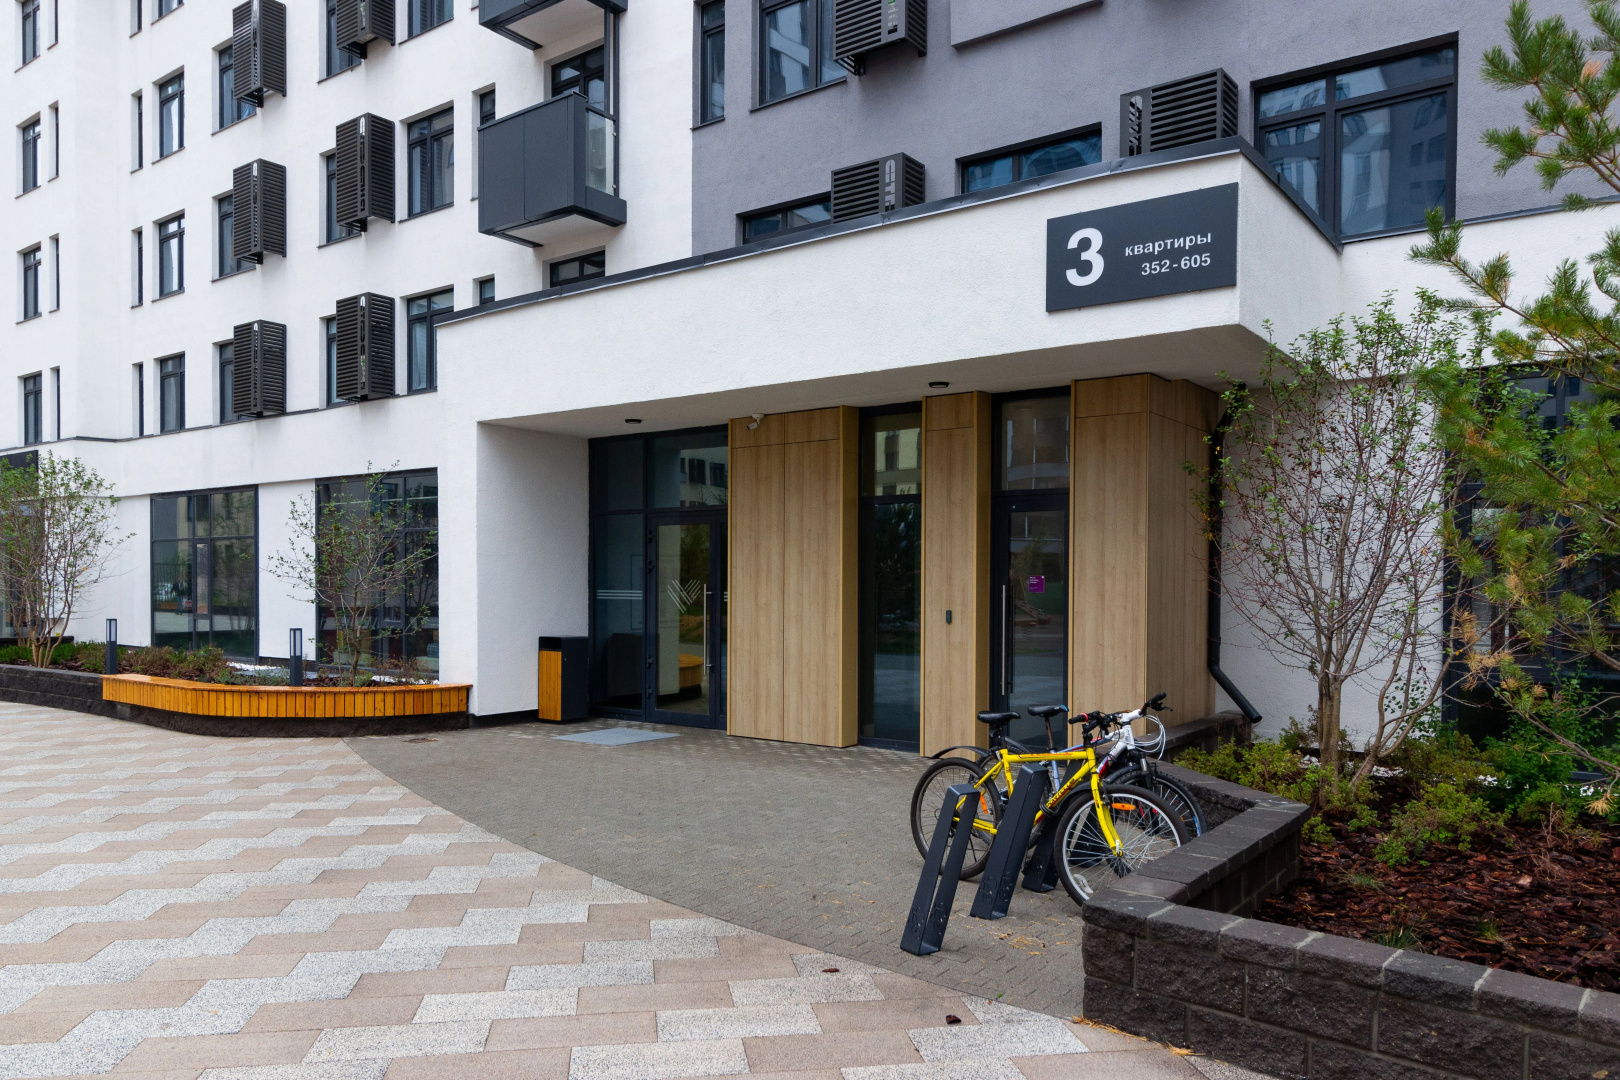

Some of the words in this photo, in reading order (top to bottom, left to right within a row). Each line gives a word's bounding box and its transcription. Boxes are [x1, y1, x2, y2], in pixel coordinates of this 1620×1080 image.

[1065, 227, 1105, 287] 3
[1125, 232, 1212, 257] квартиры
[1141, 253, 1211, 276] 352-605
